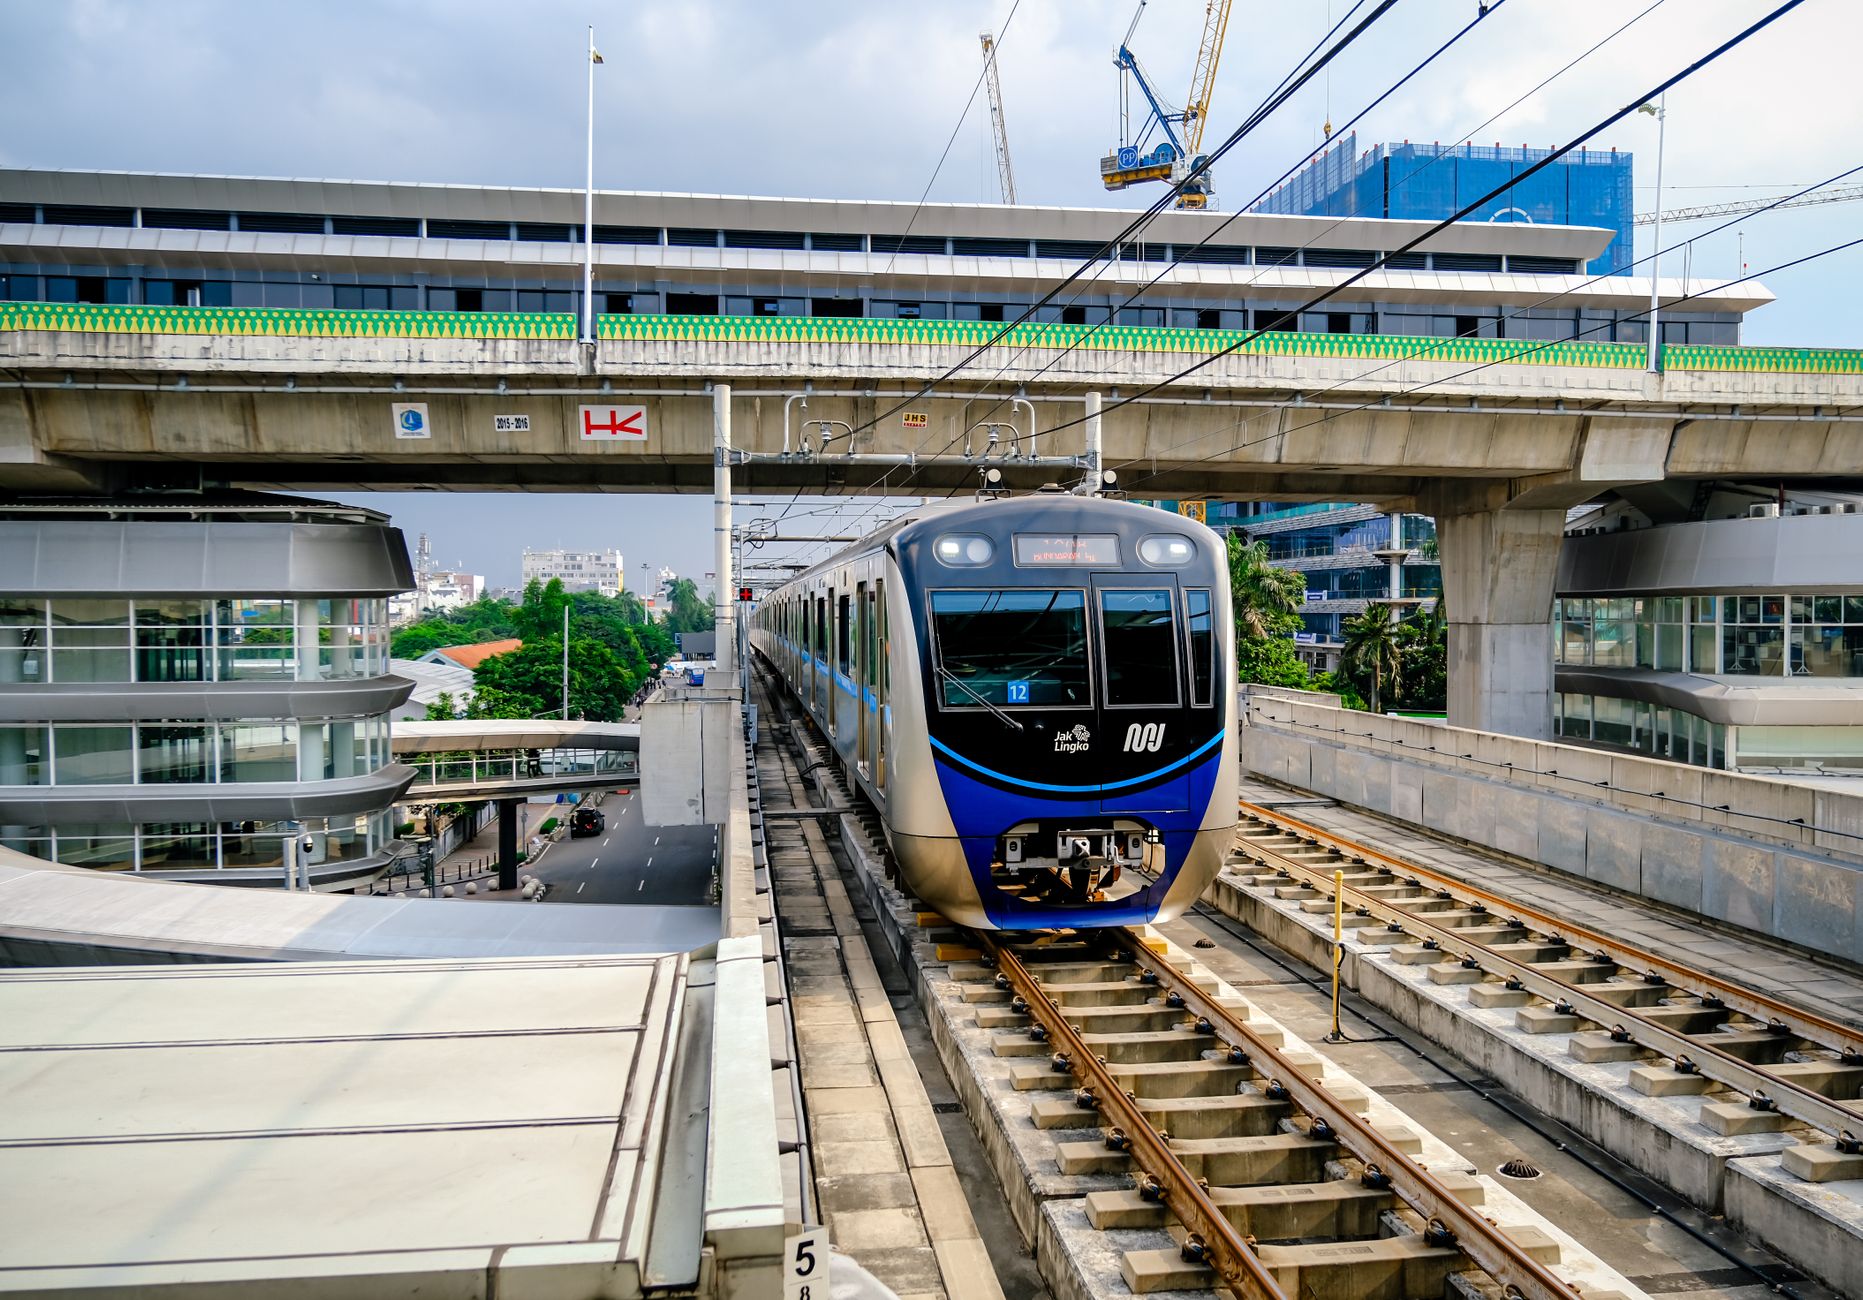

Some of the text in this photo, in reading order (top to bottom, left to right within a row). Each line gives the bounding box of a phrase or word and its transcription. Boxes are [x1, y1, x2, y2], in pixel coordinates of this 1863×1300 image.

[904, 413, 926, 423] JHS
[1010, 685, 1027, 700] 12
[1054, 731, 1073, 742] Jak
[1054, 741, 1089, 754] Lingko
[795, 1240, 816, 1277] 5
[799, 1285, 811, 1300] 8
